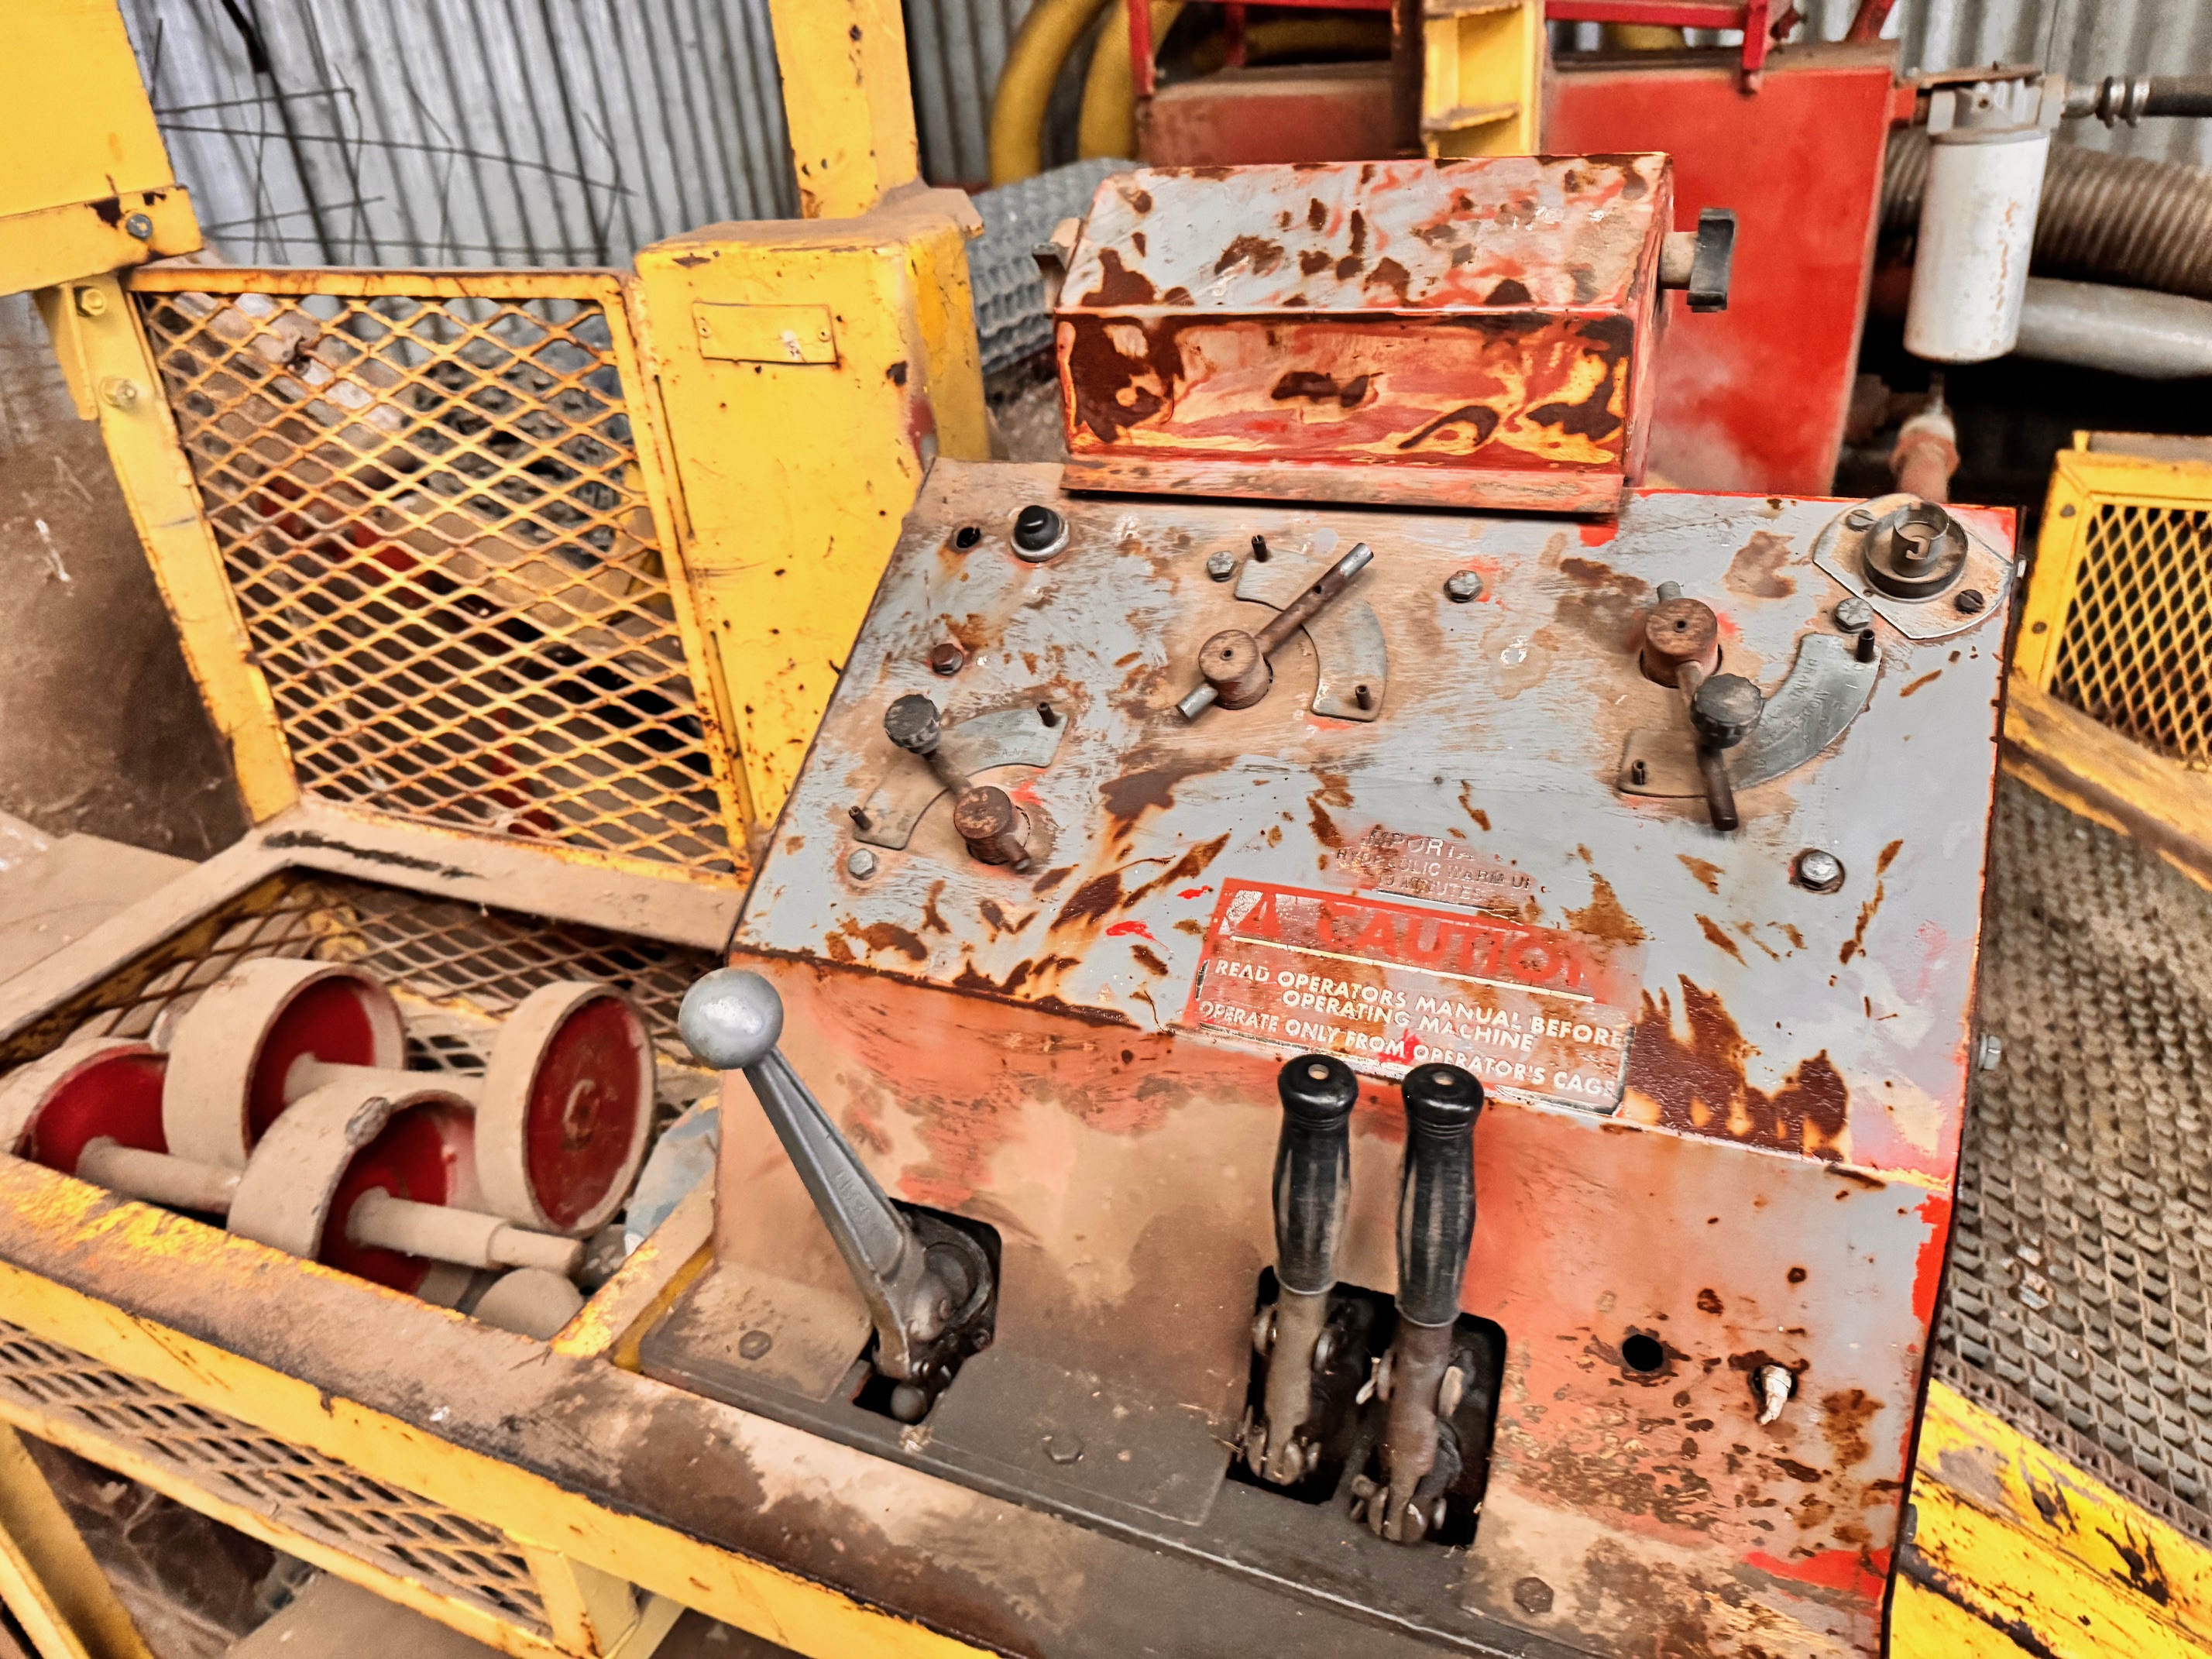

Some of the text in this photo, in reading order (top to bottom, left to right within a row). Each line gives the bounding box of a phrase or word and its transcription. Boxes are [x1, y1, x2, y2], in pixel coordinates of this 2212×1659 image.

[1199, 1001, 1616, 1096] OPERATE ONLY FROM OPERATOR'S CAGE
[1215, 959, 1625, 1049] READ OPERATORS MANUAL BEFORE
[1282, 989, 1535, 1052] OPERATING MACHINE
